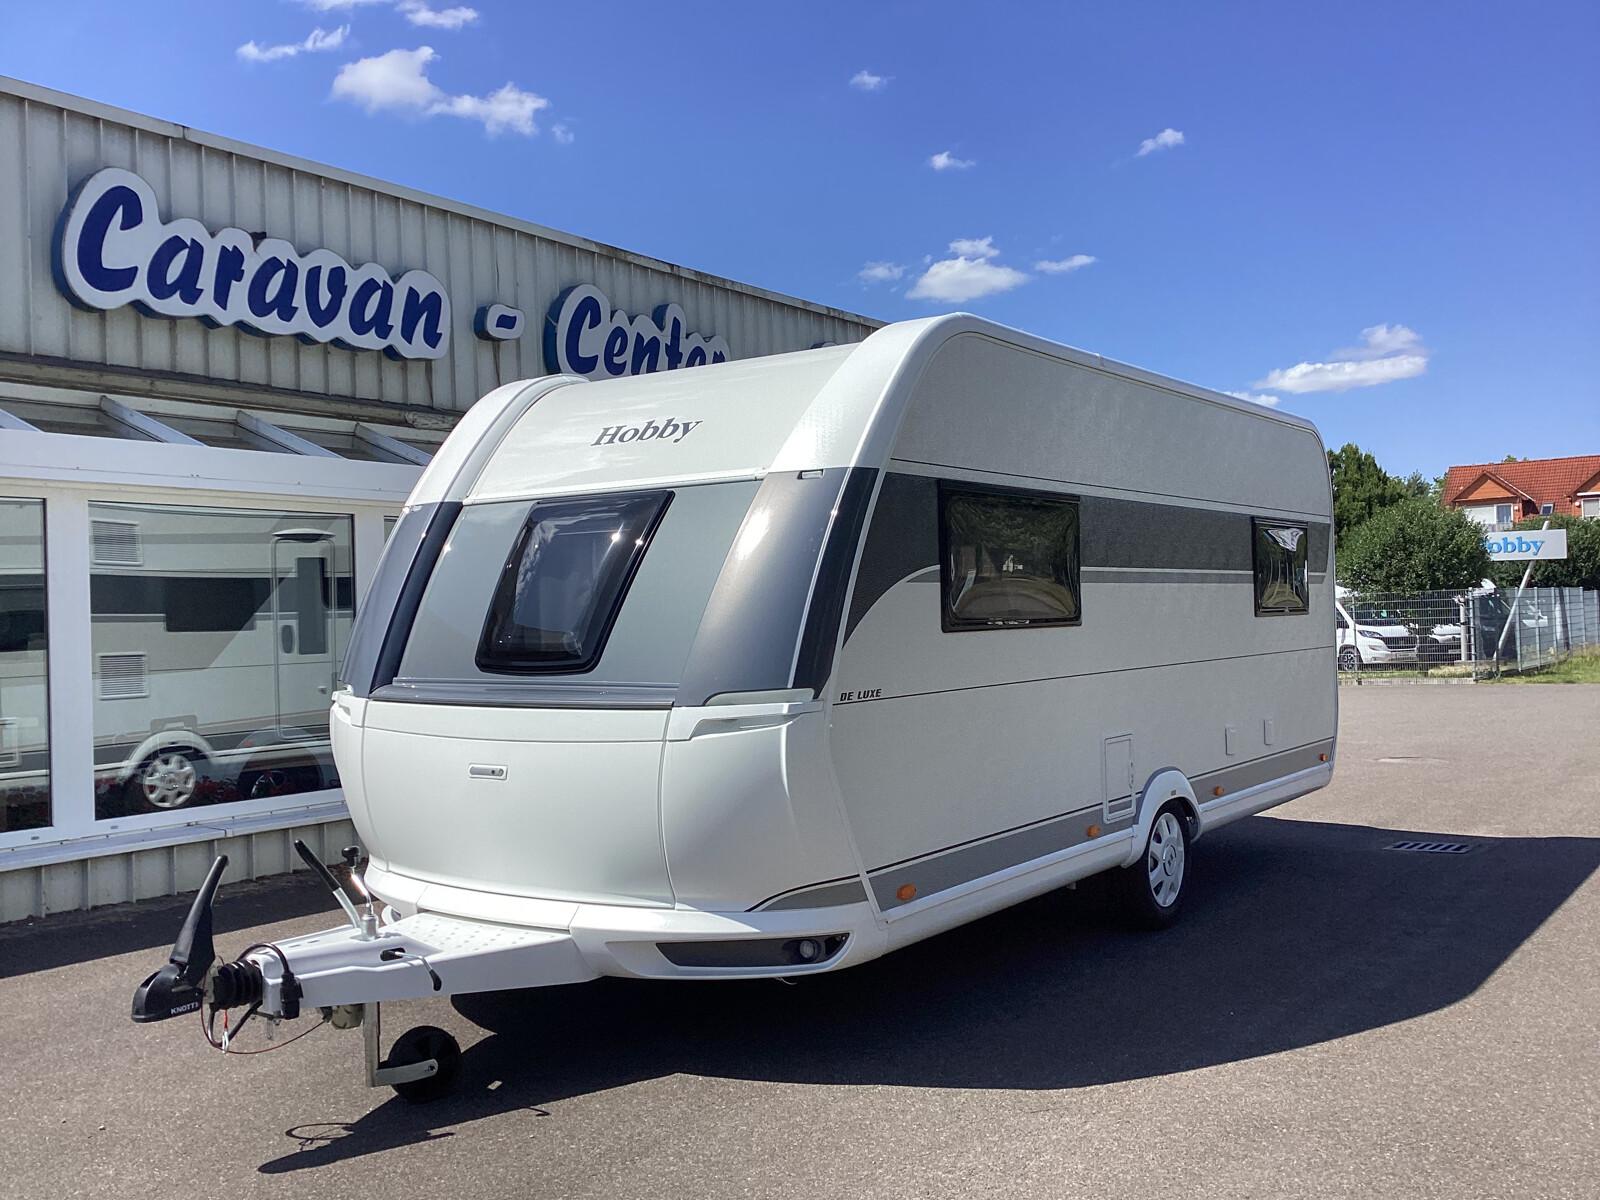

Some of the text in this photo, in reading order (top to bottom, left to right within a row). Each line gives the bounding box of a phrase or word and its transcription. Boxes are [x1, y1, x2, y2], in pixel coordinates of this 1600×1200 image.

[77, 185, 443, 349] Caravan
[590, 417, 704, 447] Hobby
[1486, 536, 1546, 556] obby
[840, 688, 882, 702] DE LUXE
